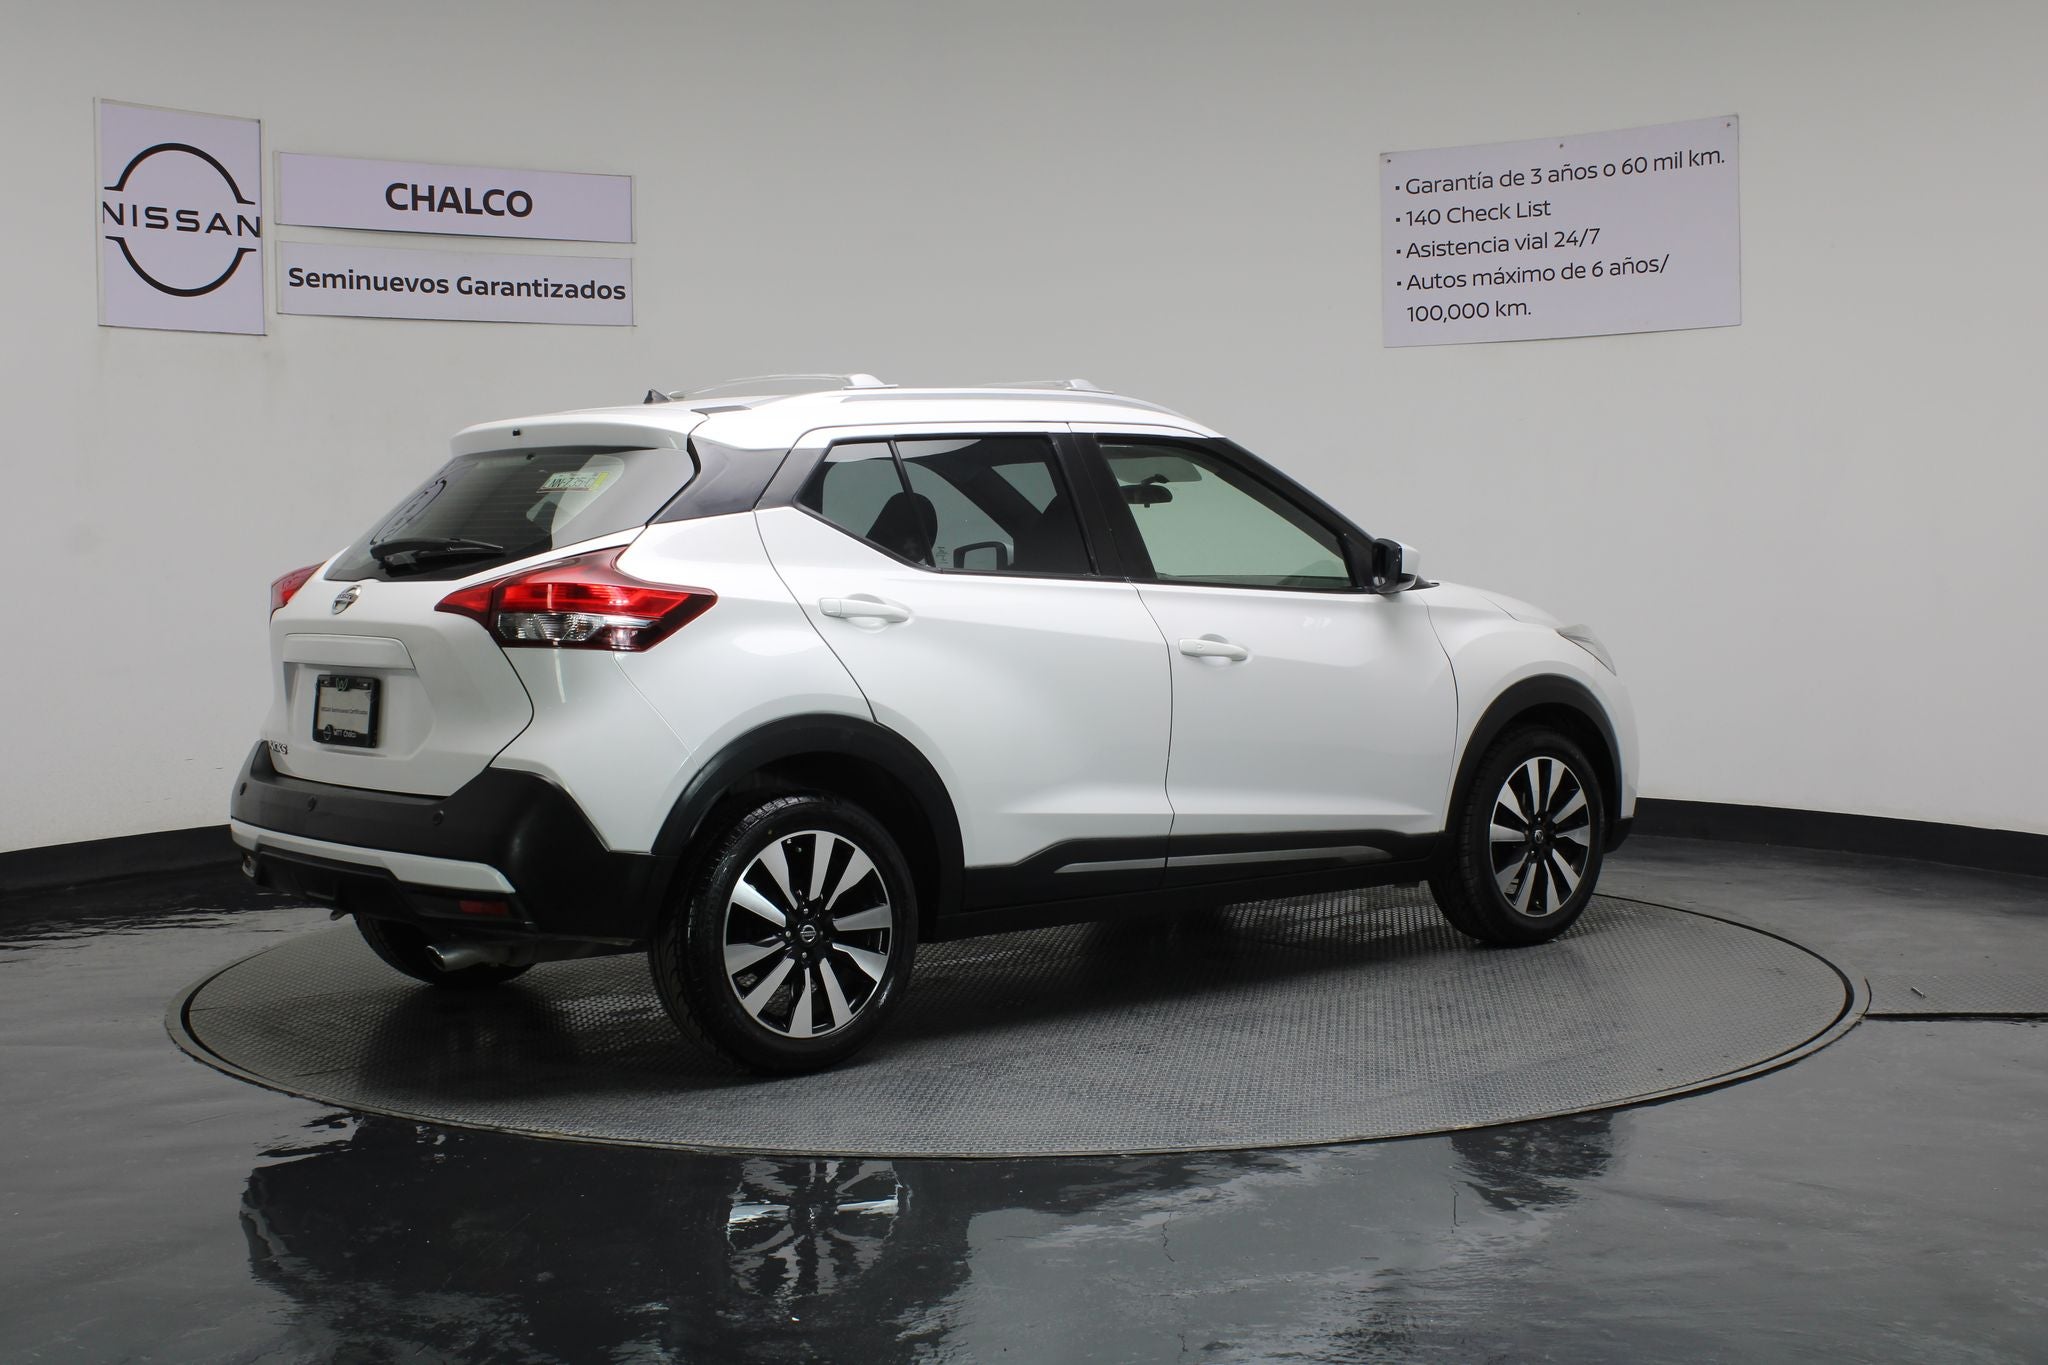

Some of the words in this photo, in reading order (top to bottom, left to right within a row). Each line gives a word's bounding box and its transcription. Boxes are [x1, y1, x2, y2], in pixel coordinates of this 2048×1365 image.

[1405, 171, 1494, 195] Garantía
[1499, 169, 1525, 188] de
[1530, 167, 1543, 185] 3
[1547, 162, 1598, 183] años
[1602, 163, 1617, 178] o
[1621, 156, 1648, 176] 60
[1653, 150, 1683, 172] mil
[1688, 149, 1725, 168] km.
[385, 182, 534, 218] CHALCO
[1405, 208, 1441, 227] 140
[1446, 202, 1511, 224] Check
[1516, 199, 1552, 219] List
[102, 200, 261, 239] NISSAN
[1405, 235, 1510, 259] Asistencia
[1514, 231, 1548, 251] vial
[1553, 227, 1601, 248] 24/7
[288, 267, 450, 295] Seminuevos
[456, 275, 627, 301] Garantizados
[1406, 273, 1467, 291] Autos
[1472, 266, 1556, 287] máximo
[1560, 261, 1587, 281] de
[1591, 260, 1604, 278] 6
[1609, 253, 1670, 277] años/
[1406, 301, 1490, 324] 100,000
[1495, 300, 1532, 318] km.
